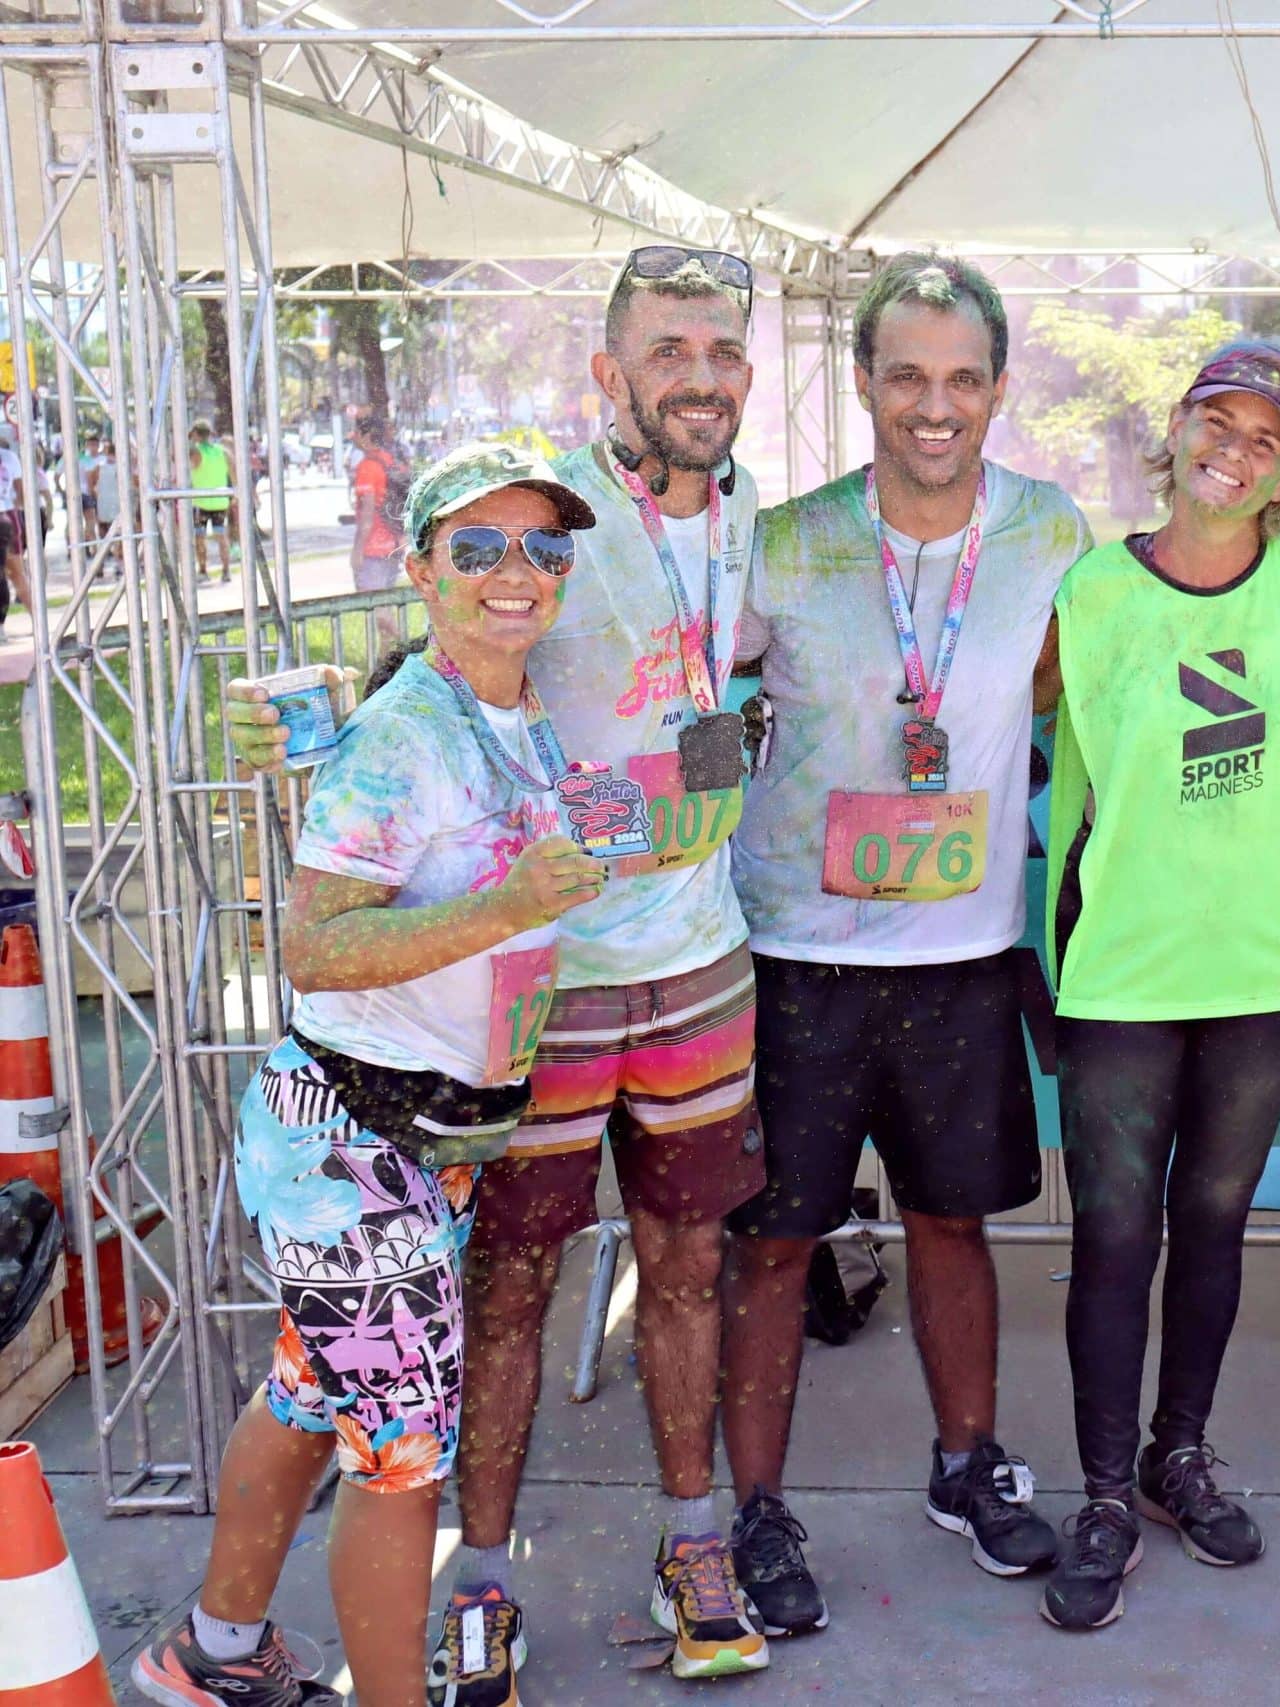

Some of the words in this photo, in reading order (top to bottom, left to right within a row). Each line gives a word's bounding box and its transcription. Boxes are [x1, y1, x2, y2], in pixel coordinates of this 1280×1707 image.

[894, 607, 906, 633] RUN
[945, 629, 958, 655] RUN
[661, 709, 684, 728] RUN
[1181, 748, 1265, 787] SPORT
[1179, 770, 1265, 806] MADNESS
[647, 788, 733, 854] 007
[946, 803, 974, 819] 10K
[614, 831, 645, 845] 2024
[852, 830, 974, 884] 076
